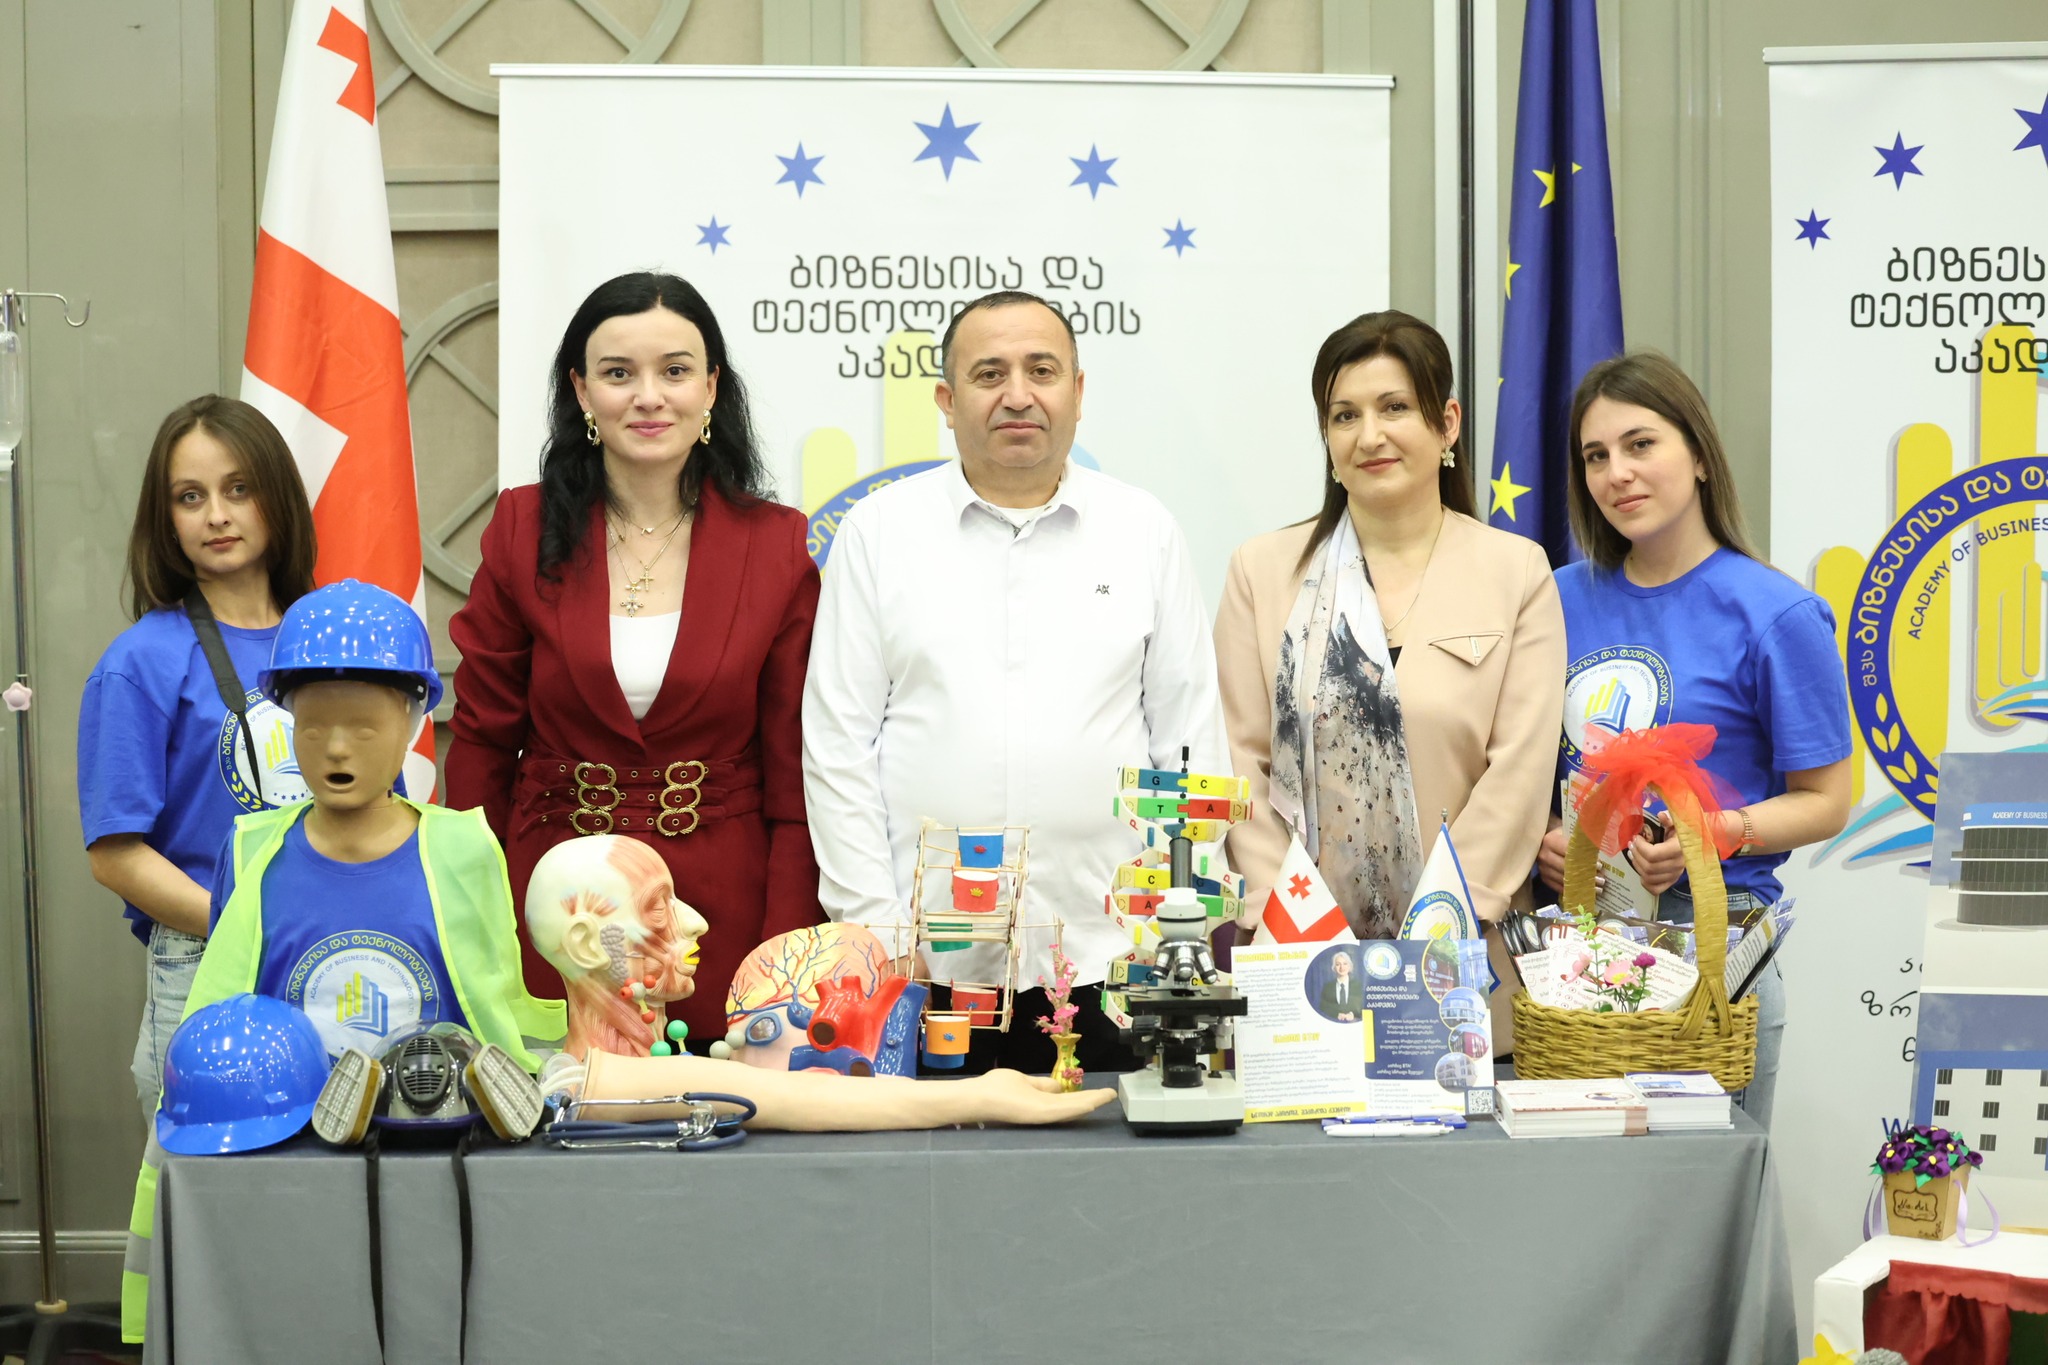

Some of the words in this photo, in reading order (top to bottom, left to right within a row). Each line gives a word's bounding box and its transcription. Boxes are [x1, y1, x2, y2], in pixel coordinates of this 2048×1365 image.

[790, 255, 1023, 290] ბიზნესისა
[1043, 255, 1103, 290] და
[1887, 246, 2046, 282] ბიზნეს
[752, 299, 1142, 335] ტექნოლბის
[1850, 292, 2046, 328] ტექნოლ
[838, 344, 945, 379] აკად
[1854, 494, 1960, 645] ბიზნესისა
[1963, 471, 2012, 503] და
[1908, 560, 1951, 640] ACADEMY
[1951, 540, 1972, 562] OF
[1601, 649, 1617, 660] და
[246, 691, 264, 704] და
[1151, 776, 1160, 786] G
[1200, 779, 1208, 789] C
[1157, 804, 1164, 814] T
[1206, 804, 1214, 813] A
[1992, 811, 2015, 819] ACADEMY
[2015, 811, 2022, 819] OF
[2022, 811, 2048, 819] BUSINESS
[1144, 901, 1153, 910] A
[289, 945, 329, 1001] ბიზნესისა
[329, 936, 349, 950] და
[351, 934, 434, 1002] ტექნოლოგიების
[310, 971, 326, 1000] ACADEMY
[325, 963, 334, 972] OF
[335, 954, 370, 966] BUSINESS
[371, 956, 386, 966] AND
[387, 962, 415, 1002] TECHNOLOGY
